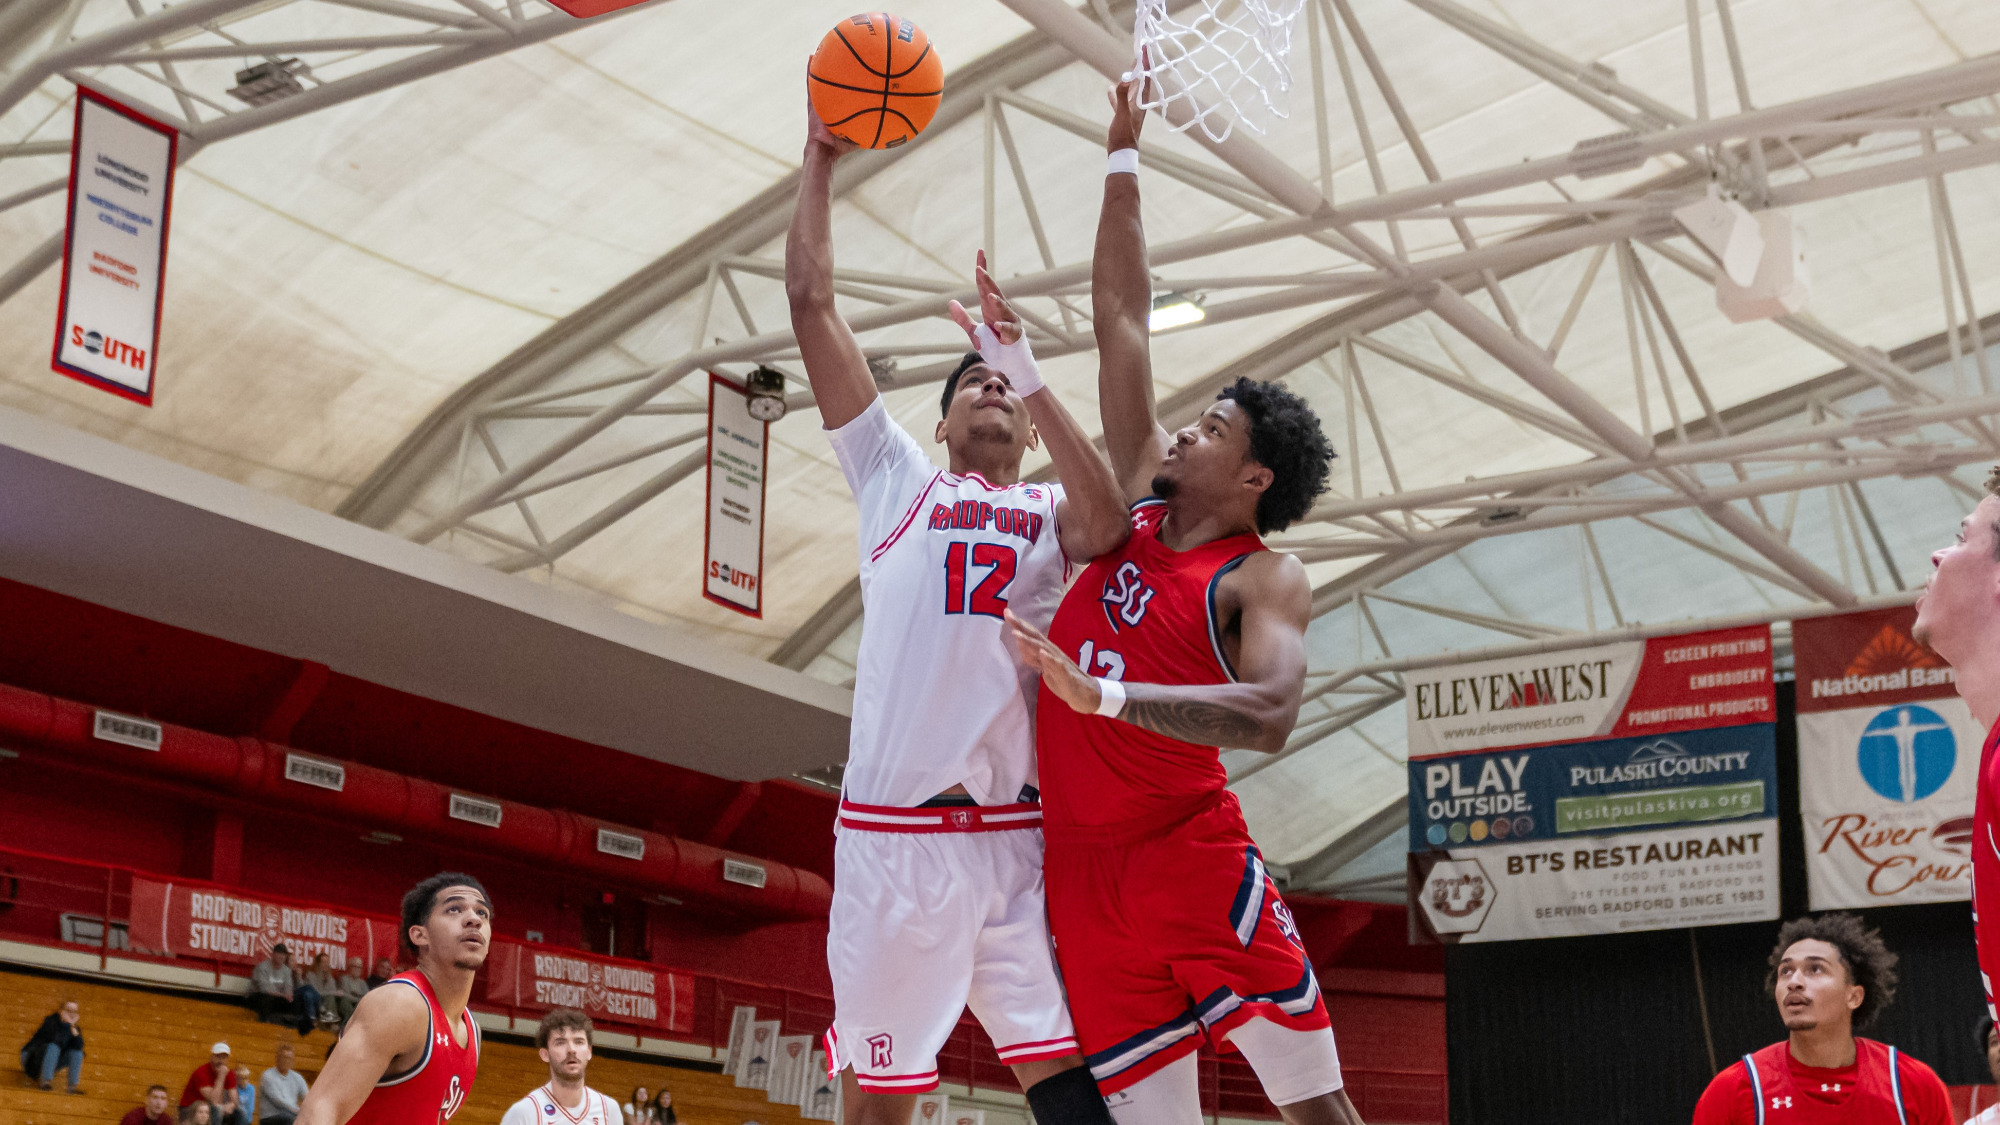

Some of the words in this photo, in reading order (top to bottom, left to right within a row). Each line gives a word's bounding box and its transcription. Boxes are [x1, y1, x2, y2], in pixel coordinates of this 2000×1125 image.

[927, 499, 1043, 547] RADFORD
[943, 541, 1018, 621] 12
[1097, 560, 1156, 628] SU
[1663, 645, 1709, 664] SCREEN
[1710, 637, 1766, 658] PRINTING
[1415, 671, 1525, 721] ELEVEN
[1531, 660, 1613, 705] WEST
[1689, 667, 1767, 690] EMBROIDERY
[1811, 668, 1908, 698] National
[1443, 713, 1585, 740] www.elevenwest.com
[1628, 704, 1707, 726] PROMOTIONAL
[1709, 696, 1769, 717] PRODUCTS
[1426, 755, 1530, 800] PLAY
[1570, 761, 1657, 787] PULASKI
[1658, 751, 1750, 777] COUNTY
[1427, 792, 1533, 820] OUTSIDE.
[1565, 791, 1753, 821] visitpulaskiva.org
[1507, 851, 1566, 876] BT'S
[1573, 832, 1764, 870] RESTAURANT
[1818, 813, 1927, 867] River
[1867, 855, 1972, 896] Cour
[190, 891, 262, 929] RADFORD
[281, 908, 348, 943] ROWDIES
[1535, 904, 1598, 919] SERVING
[1603, 897, 1674, 915] RADFORD
[1679, 893, 1724, 908] SINCE
[189, 923, 258, 958] STUDENT
[534, 954, 589, 984] RADFORD
[603, 965, 656, 996] ROWDIES
[535, 980, 587, 1010] STUDENT
[606, 990, 658, 1021] SECTION
[866, 1032, 893, 1069] R
